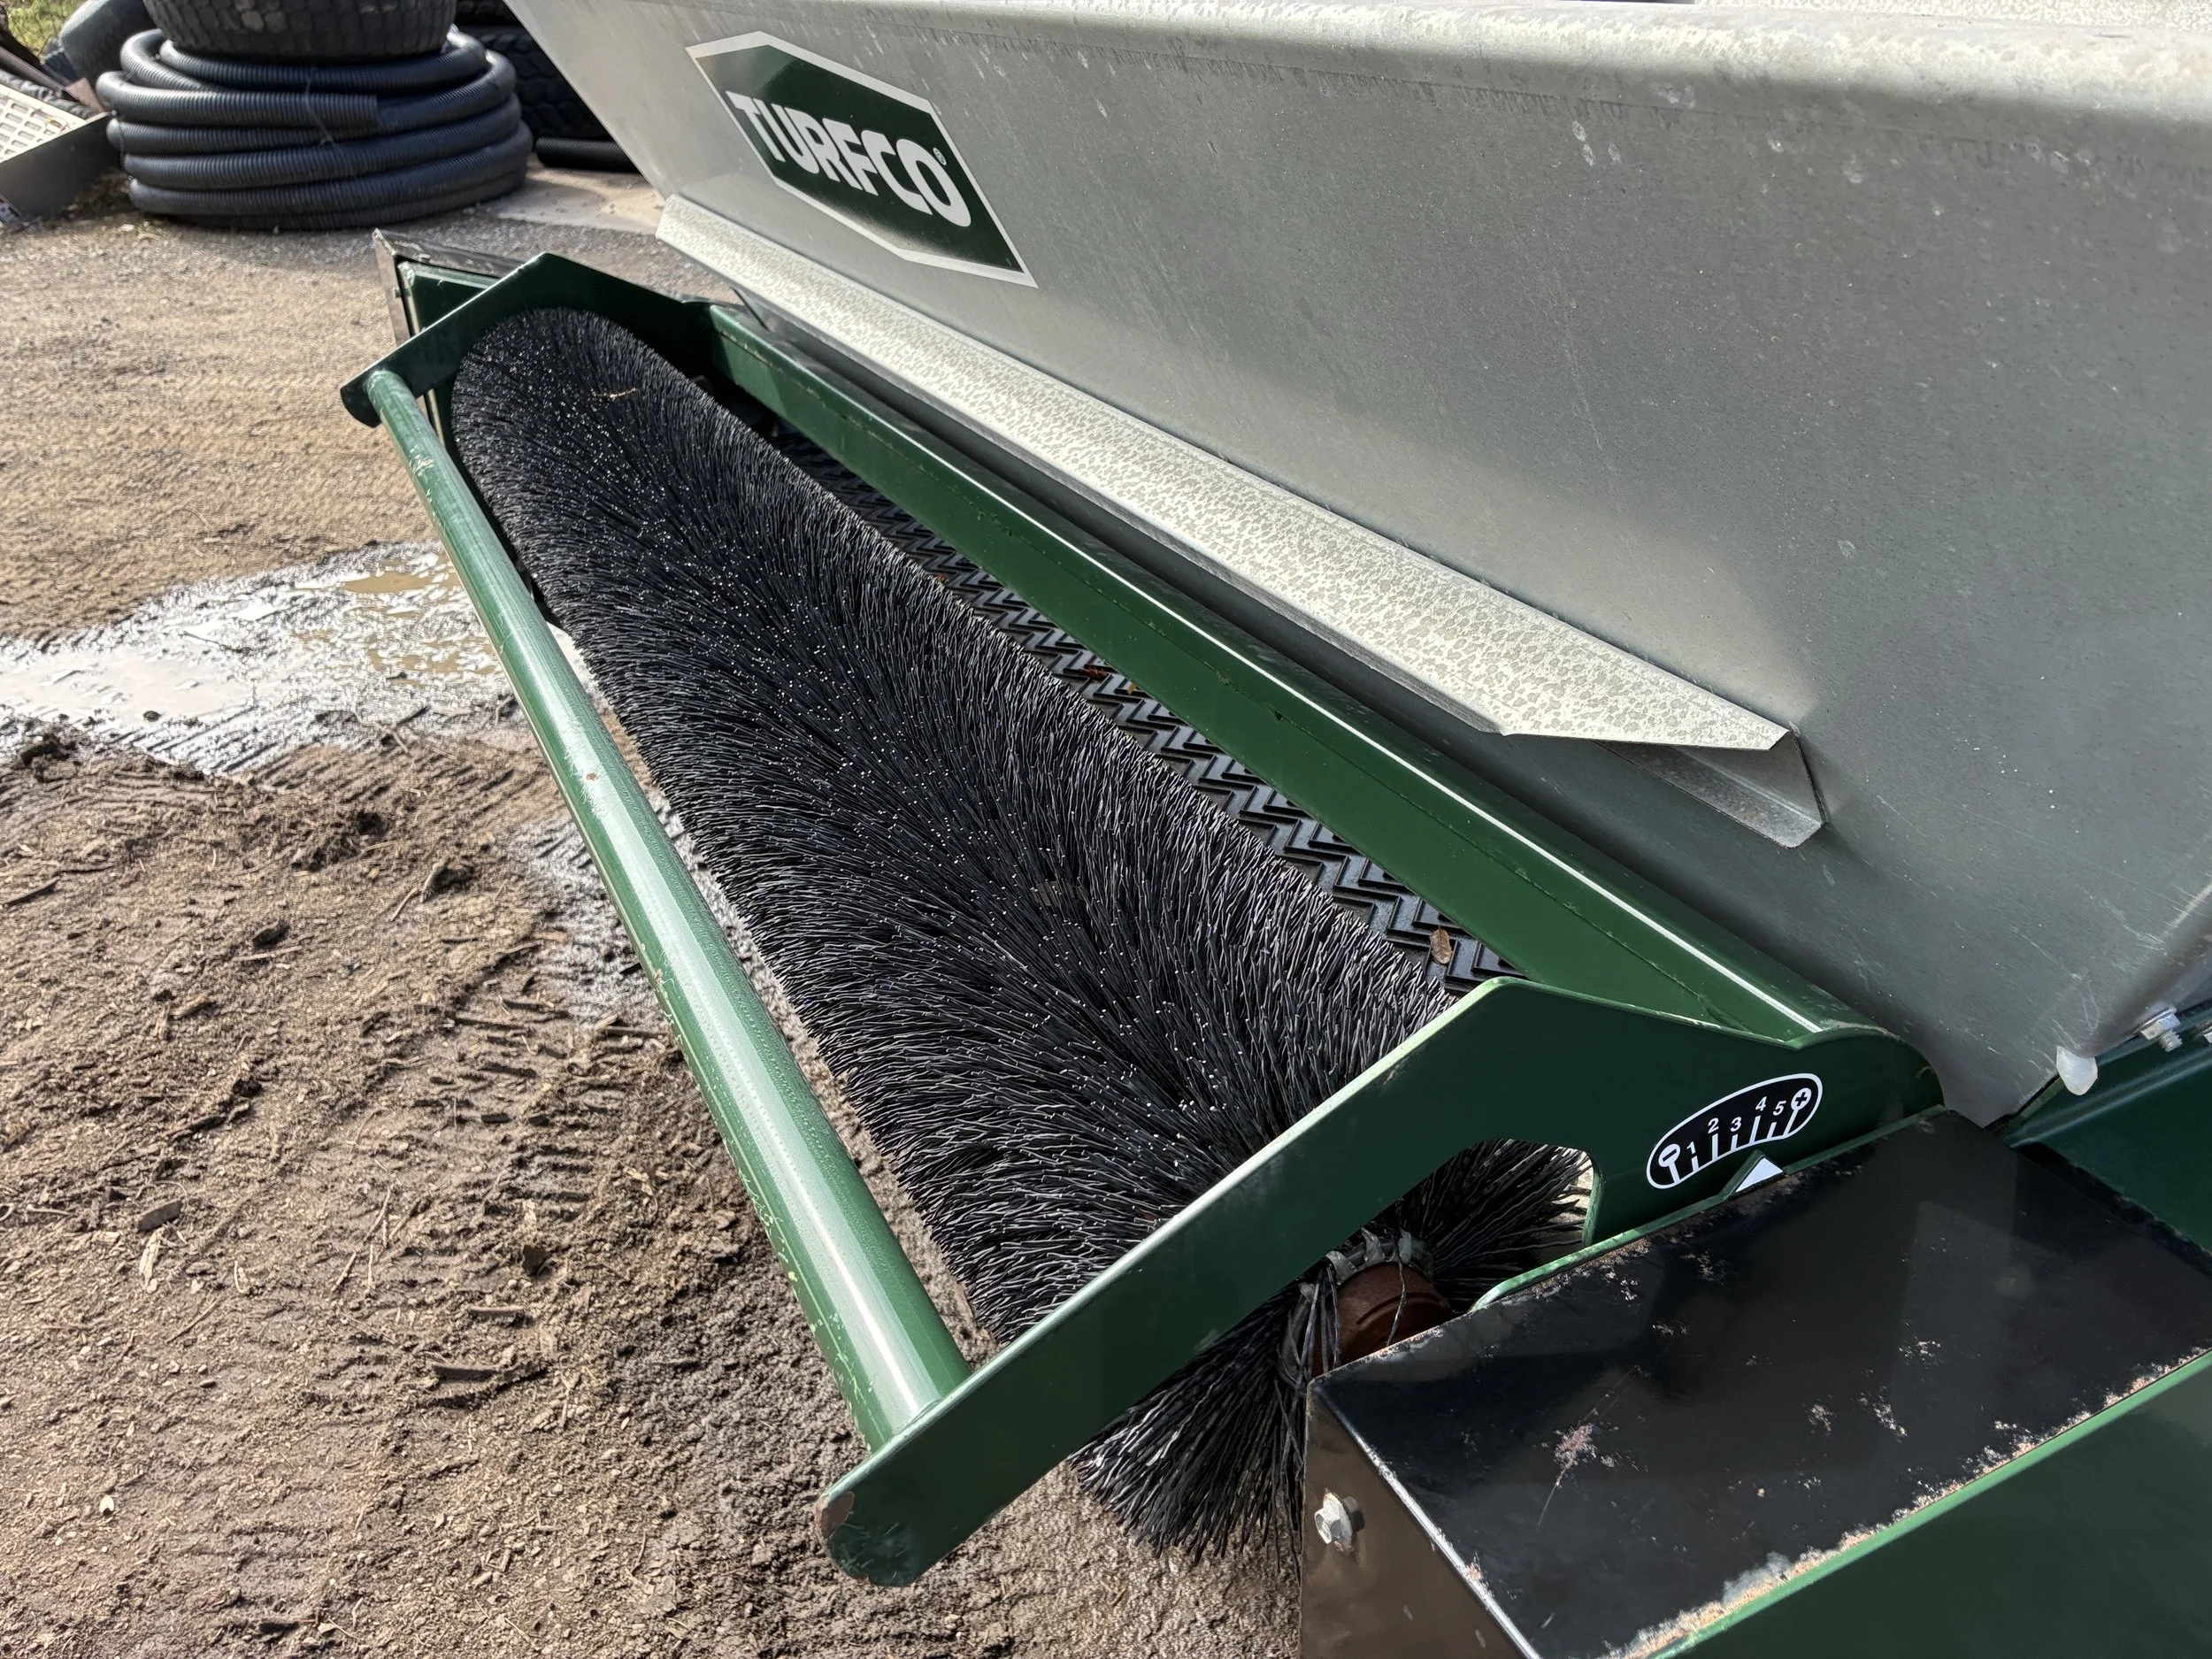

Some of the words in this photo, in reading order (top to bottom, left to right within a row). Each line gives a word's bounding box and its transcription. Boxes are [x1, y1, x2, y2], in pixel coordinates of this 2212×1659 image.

[1686, 1141, 1696, 1155] 1
[1708, 1117, 1719, 1133] 2
[1730, 1116, 1742, 1132] 3
[1755, 1096, 1768, 1111] 4
[1772, 1100, 1786, 1116] 5
